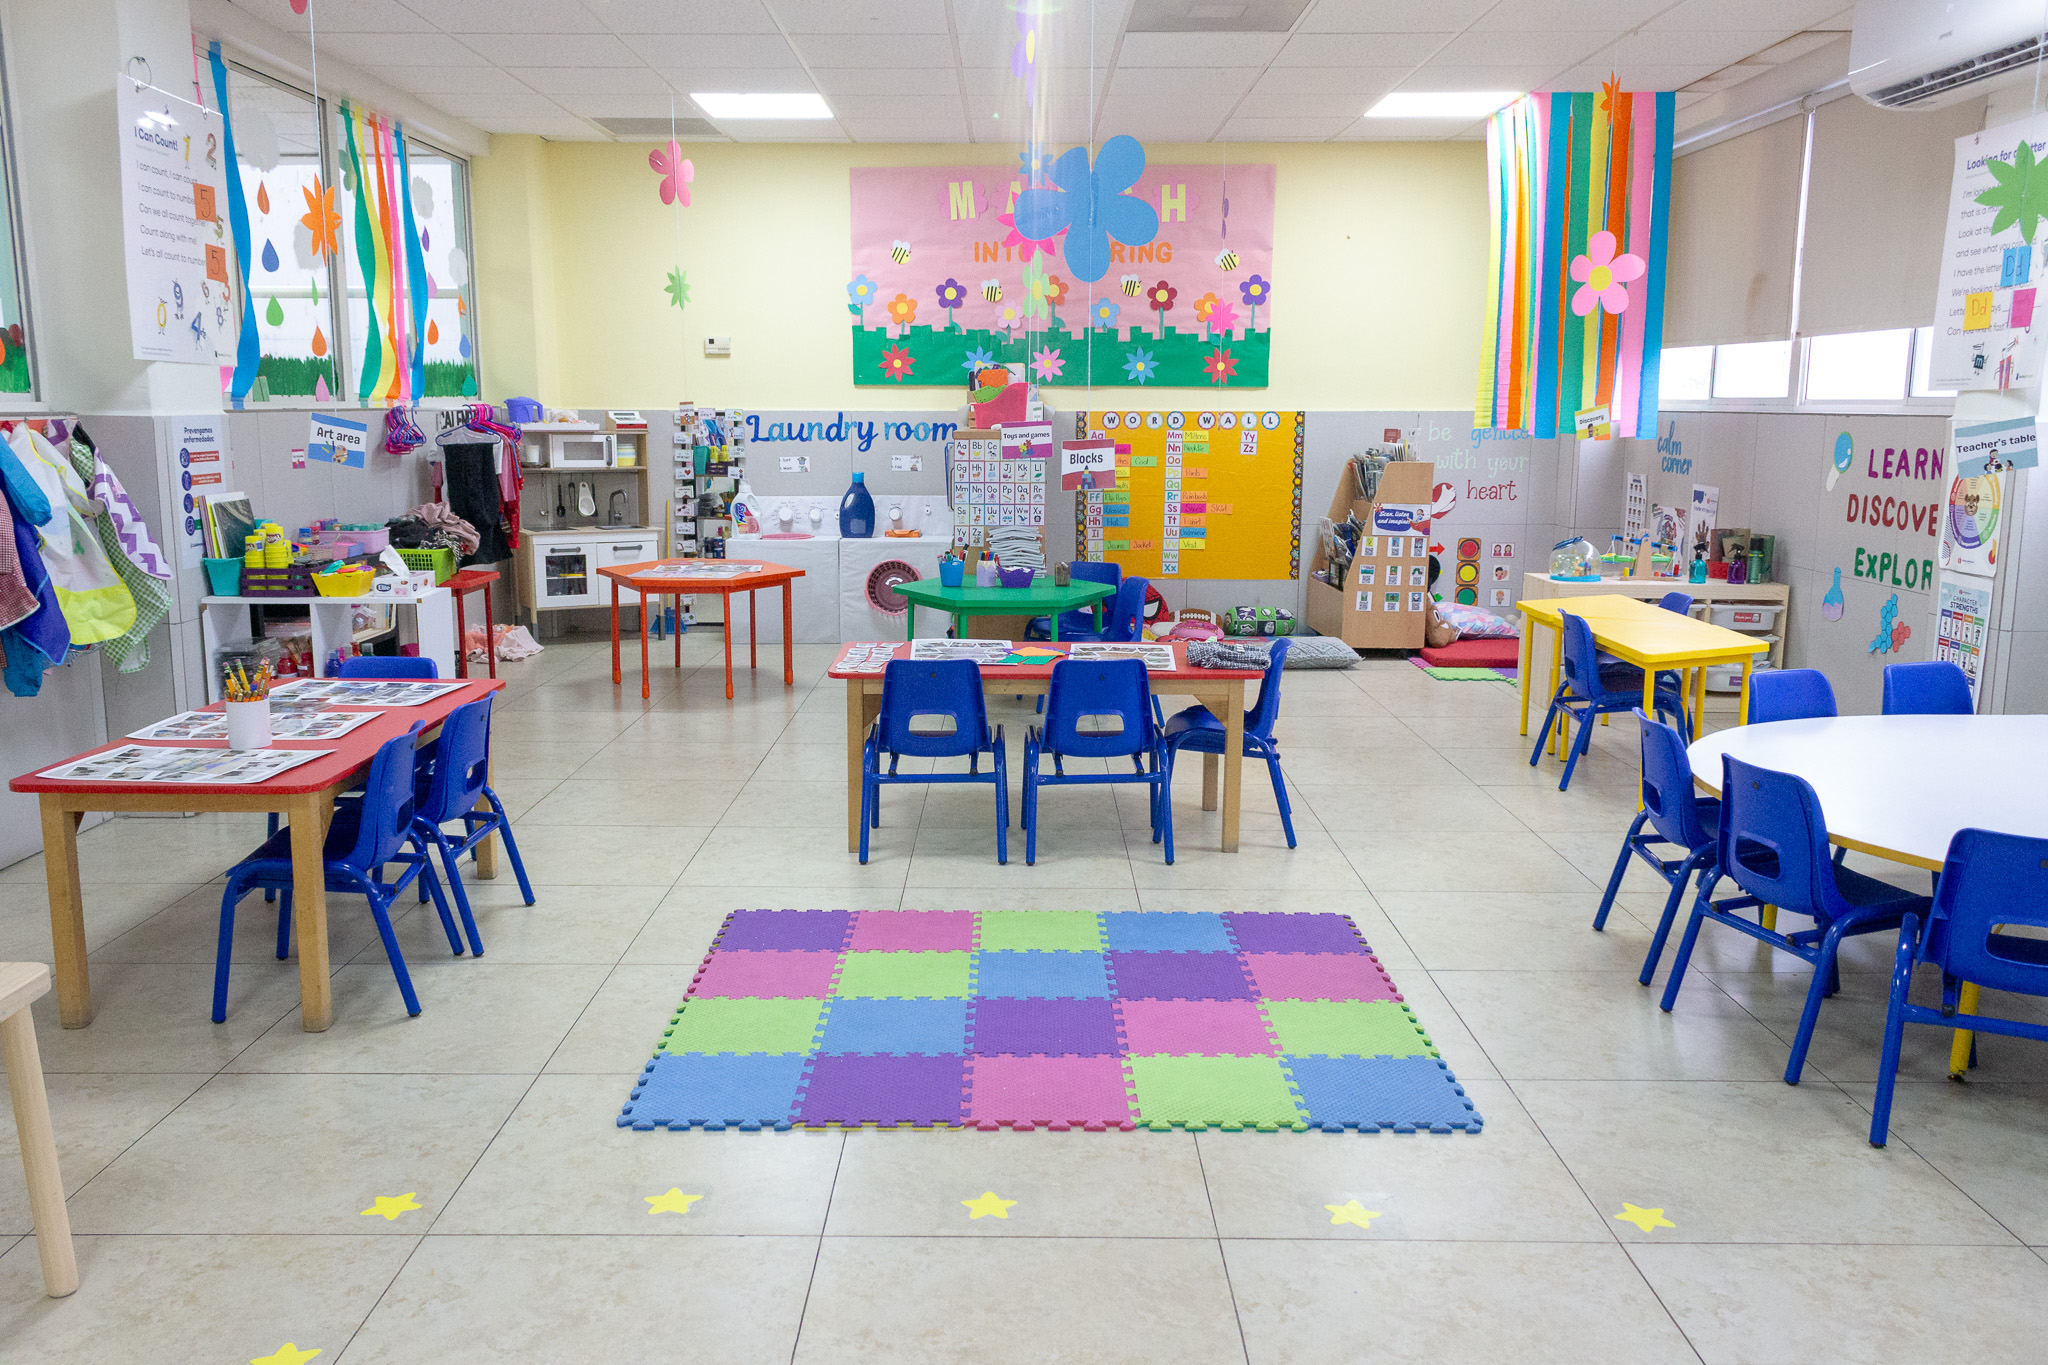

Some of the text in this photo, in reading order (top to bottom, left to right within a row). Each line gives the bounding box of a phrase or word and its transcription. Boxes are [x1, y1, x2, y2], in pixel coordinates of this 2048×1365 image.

[138, 128, 154, 143] Can
[155, 134, 178, 151] Count!
[2000, 150, 2012, 161] for
[139, 166, 152, 175] can
[141, 185, 152, 194] can
[153, 186, 169, 198] count
[170, 191, 176, 199] to
[177, 194, 195, 205] numbe
[200, 188, 211, 218] 5
[139, 203, 152, 214] Can
[169, 212, 184, 223] count
[1961, 210, 1974, 219] that
[140, 225, 160, 239] Count
[160, 228, 175, 242] along
[1958, 228, 1973, 239] Look
[1975, 228, 1982, 236] at
[141, 246, 155, 257] Let's
[164, 252, 180, 263] count
[180, 255, 186, 264] to
[1956, 249, 1969, 258] and
[1983, 244, 1998, 254] what
[210, 250, 219, 275] 5
[2006, 255, 2022, 277] Dd
[1957, 269, 1972, 277] have
[1974, 266, 1984, 274] the
[1950, 304, 2001, 316] Lette ays
[1971, 296, 1987, 316] Dd
[1947, 326, 1961, 335] Can
[1579, 414, 1604, 425] Discovery
[317, 427, 360, 445] Art area
[746, 411, 958, 452] Laundry room
[1031, 432, 1050, 440] games
[1091, 431, 1103, 439] Aa
[1428, 420, 1452, 441] be
[1243, 432, 1255, 442] Yy
[1657, 420, 1682, 456] calm
[956, 442, 966, 450] Aa
[1168, 444, 1180, 452] Nn
[1243, 444, 1254, 452] Zz
[1956, 434, 2036, 454] Teacher's table
[1070, 453, 1103, 465] Blocks
[1167, 456, 1180, 464] Oo
[1436, 448, 1530, 478] with your
[1868, 448, 1944, 480] LEARN
[956, 464, 966, 473] Gg
[1004, 464, 1012, 472] Jj
[1662, 456, 1692, 475] corner
[1168, 468, 1179, 478] Pp
[1003, 486, 1012, 494] Pp
[1017, 486, 1028, 494] Qq
[1166, 480, 1179, 490] Qq
[1466, 480, 1517, 501] heart
[1090, 493, 1100, 501] Ff
[1167, 492, 1178, 500] Rr
[1089, 505, 1101, 516] Gg
[1168, 504, 1177, 512] Ss
[1089, 517, 1100, 525] Hh
[1168, 516, 1176, 524] Tt
[1847, 494, 1938, 537] DISCOVE
[956, 529, 966, 538] Yy
[1166, 528, 1177, 536] Uu
[1090, 553, 1102, 561] Kk
[1854, 547, 1933, 591] EXPLOR
[1953, 596, 1977, 605] CHARACTER
[1950, 602, 1978, 614] STRENGTHS
